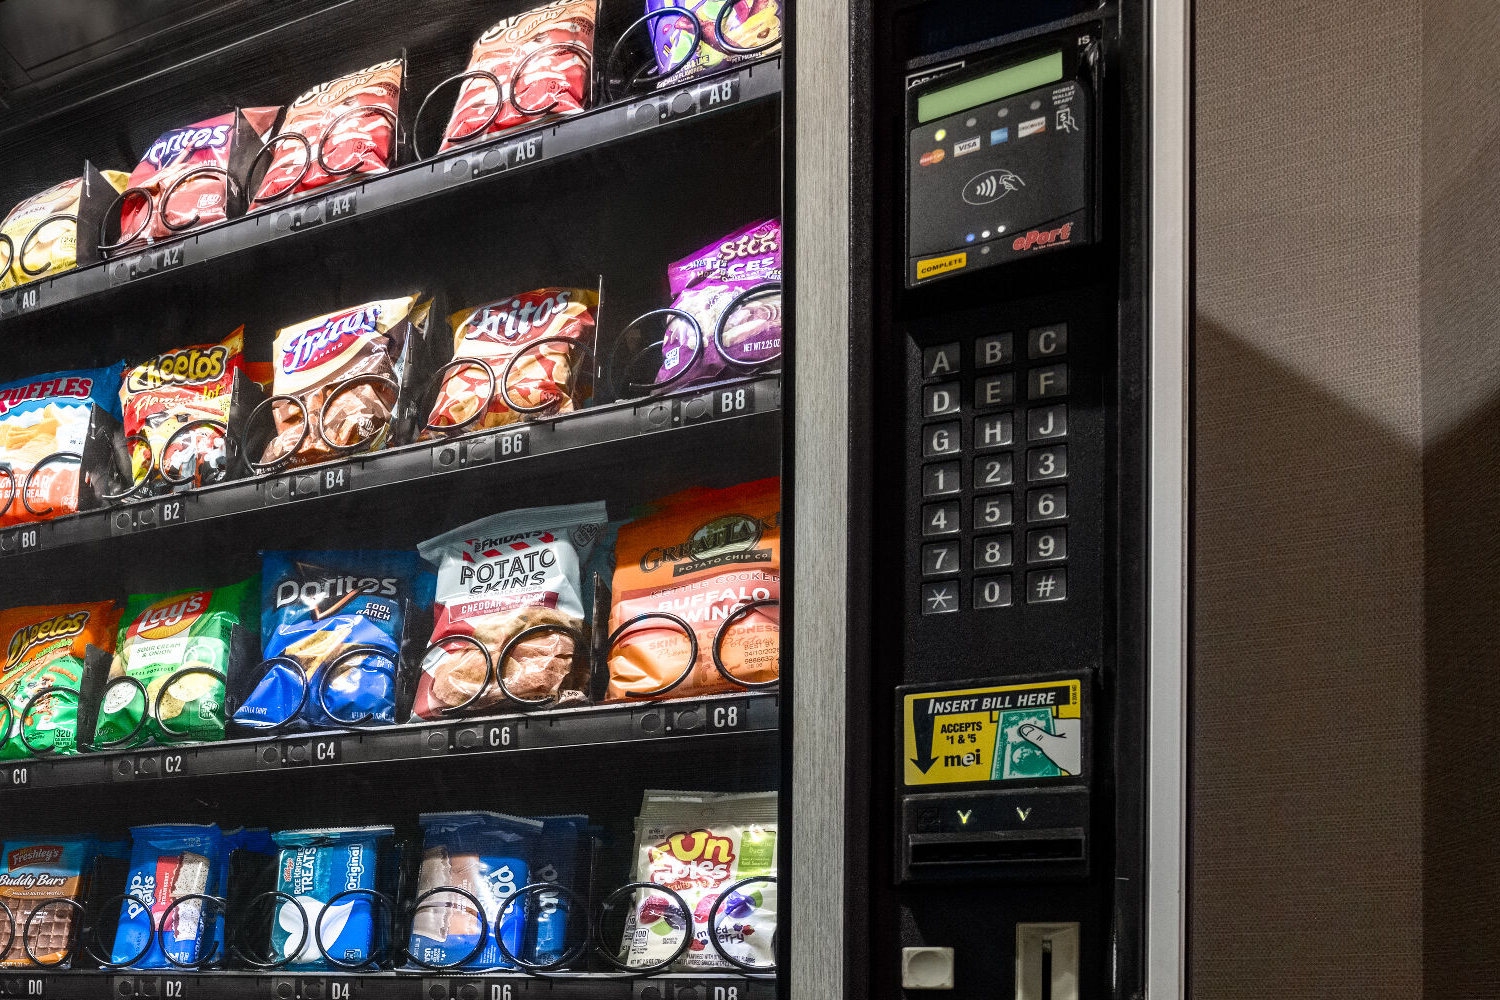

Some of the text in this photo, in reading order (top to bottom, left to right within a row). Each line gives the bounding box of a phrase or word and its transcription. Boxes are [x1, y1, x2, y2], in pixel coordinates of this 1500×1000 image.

[506, 9, 562, 42] Crunchy
[709, 81, 732, 104] A8
[141, 125, 230, 163] oritos
[516, 141, 536, 161] A6
[958, 142, 977, 152] VISA
[333, 200, 350, 216] A4
[1012, 222, 1071, 251] ePort
[163, 249, 179, 268] A2
[921, 257, 963, 274] COMPLETE
[465, 291, 571, 340] Fritos
[282, 304, 381, 375] Fritos
[1039, 331, 1056, 353] C
[313, 343, 343, 361] BRAND
[932, 351, 950, 374] A
[985, 341, 1001, 364] B
[129, 350, 224, 390] Cheetos
[986, 381, 1001, 404] E
[1039, 372, 1054, 395] F
[721, 389, 745, 412] B8
[933, 391, 949, 413] D
[984, 421, 1001, 443] H
[1039, 412, 1053, 435] J
[502, 433, 523, 455] B6
[932, 430, 949, 451] G
[985, 462, 1001, 483] 2
[1039, 453, 1055, 475] 3
[326, 469, 344, 489] B4
[934, 470, 944, 490] 1
[164, 503, 180, 521] B2
[985, 501, 1000, 522] 5
[1038, 493, 1054, 515] 6
[932, 509, 947, 529] 4
[480, 530, 542, 551] FRIDAYS
[1038, 535, 1055, 557] 9
[933, 549, 948, 569] 7
[984, 541, 1000, 563] 8
[460, 548, 557, 585] POTATO
[678, 557, 721, 573] POTATO
[276, 575, 398, 609] Doritos
[470, 571, 546, 595] SKINS
[650, 581, 709, 599] KETTLE
[984, 581, 1000, 603] 0
[366, 602, 390, 613] COOL
[461, 601, 501, 614] CHEDDAR
[658, 587, 770, 612] BUFFALO
[136, 595, 203, 634] Lay's
[356, 608, 391, 621] RANCH
[3, 613, 87, 670] Cheetos
[137, 645, 156, 654] SOUR
[649, 638, 678, 650] SKIN
[928, 698, 978, 715] INSERT
[982, 695, 1012, 710] BILL
[1017, 692, 1056, 706] HERE
[713, 706, 738, 728] C8
[940, 721, 983, 734] ACCEPTS
[56, 729, 70, 738] 320
[490, 727, 510, 747] C6
[957, 734, 966, 744] &
[317, 742, 335, 760] C4
[944, 748, 982, 767] mei
[166, 756, 181, 773] C2
[13, 848, 60, 866] Freshley's
[293, 847, 305, 894] RICE KRISPIES
[301, 847, 317, 893] TREATS
[347, 846, 363, 890] Original
[37, 874, 67, 886] Bars
[167, 981, 182, 998] D2
[332, 983, 350, 1000] D4
